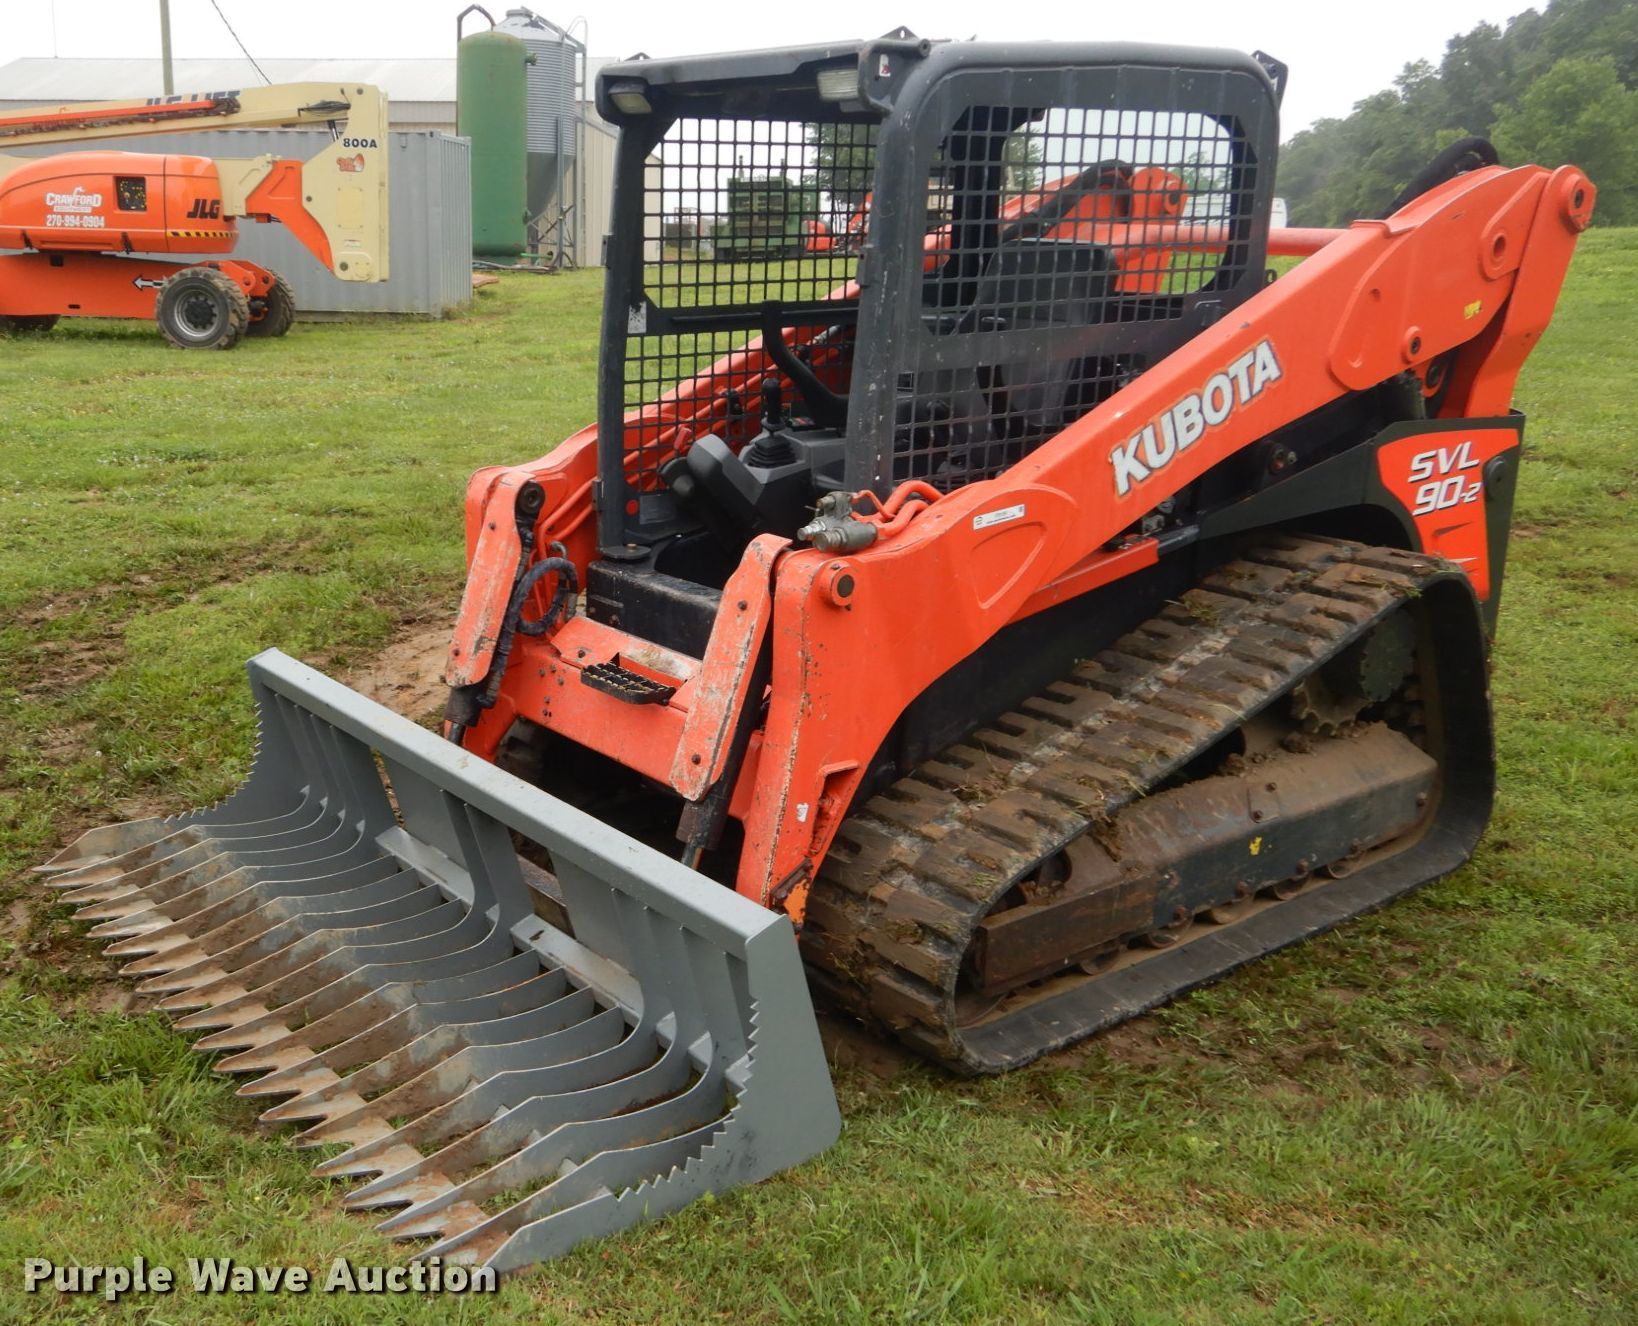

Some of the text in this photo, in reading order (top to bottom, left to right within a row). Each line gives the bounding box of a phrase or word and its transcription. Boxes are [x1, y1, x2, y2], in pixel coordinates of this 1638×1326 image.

[343, 137, 378, 149] 800A
[45, 191, 102, 207] CRAWFORD
[186, 198, 221, 220] JLG
[1109, 340, 1282, 496] KUBOTA
[1407, 441, 1480, 483] SVL
[1411, 475, 1482, 517] 90-2
